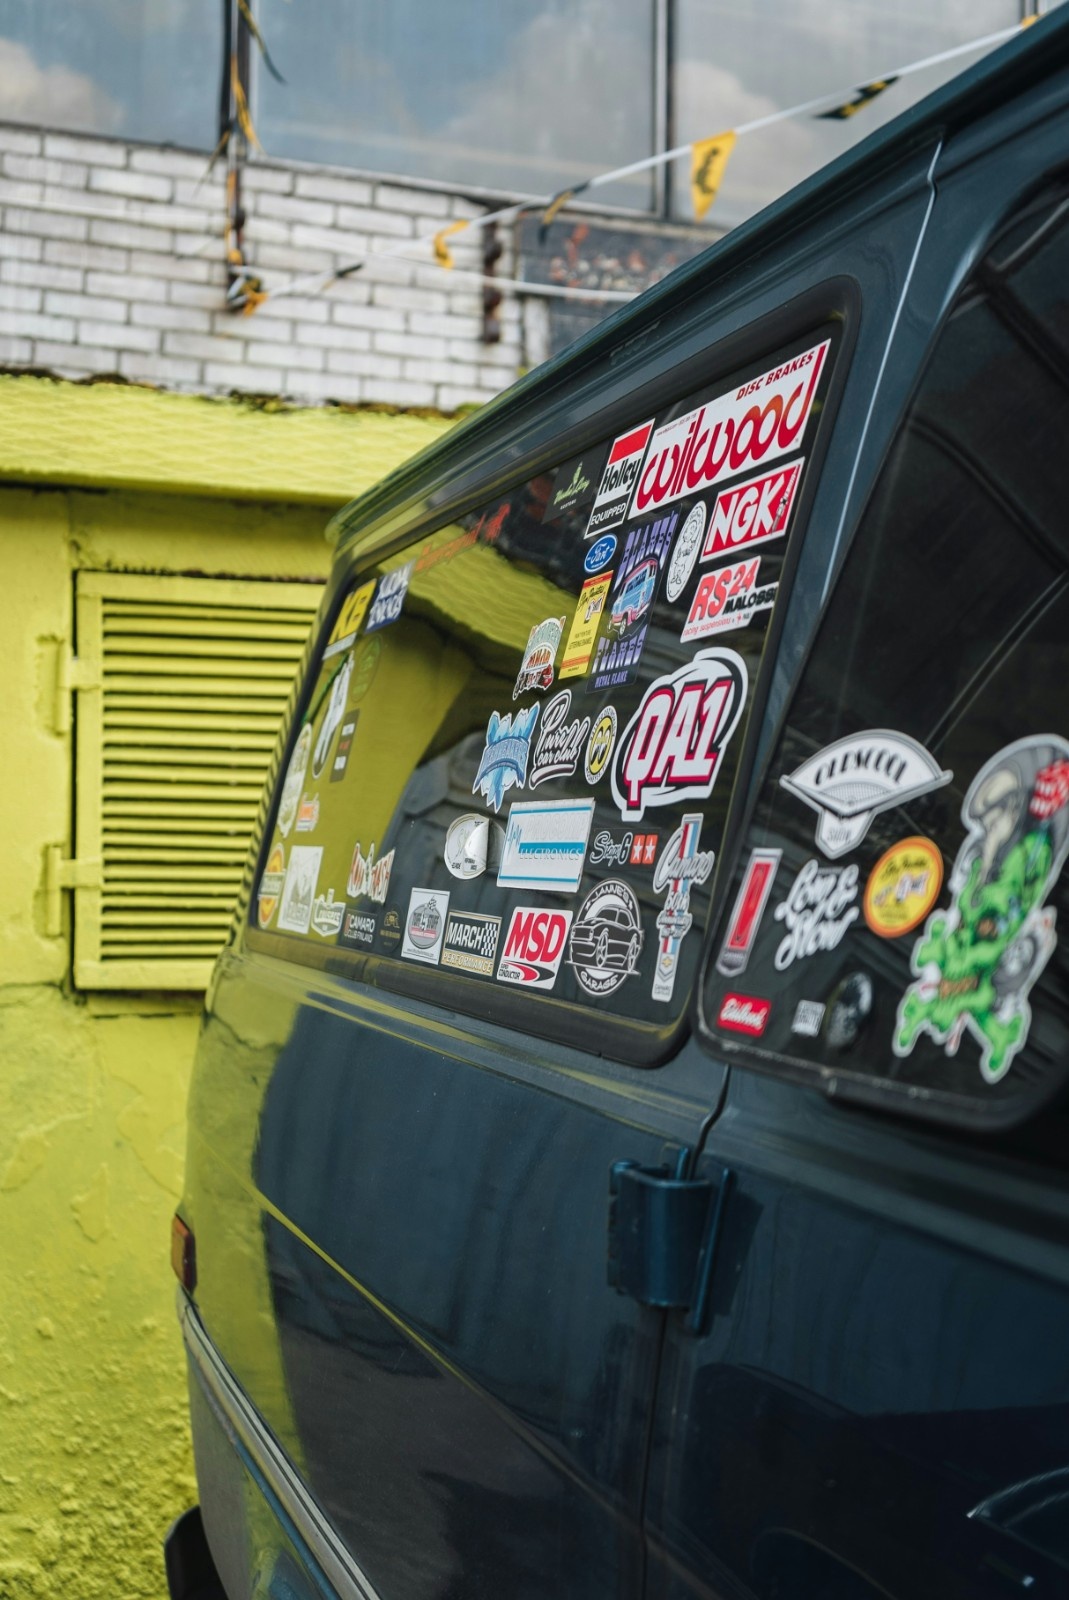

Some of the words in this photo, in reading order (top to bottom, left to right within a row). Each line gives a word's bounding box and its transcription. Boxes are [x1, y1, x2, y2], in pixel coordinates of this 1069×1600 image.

[736, 378, 764, 401] DISC
[765, 350, 815, 387] BRAKES
[636, 343, 827, 511] wilwood
[599, 457, 641, 496] Holley
[590, 502, 627, 526] EQUIPPED
[705, 472, 785, 553] NGK
[590, 542, 611, 565] Ford
[683, 626, 699, 637] racing
[700, 617, 732, 632] suspensions
[624, 678, 736, 811] QA1
[520, 847, 582, 861] ELECTRONICS
[594, 884, 630, 901] JANNE'S
[349, 914, 375, 933] CAMARO
[445, 921, 485, 951] MARCH
[504, 912, 567, 963] MSD
[443, 952, 494, 973] PERFORMANCE
[498, 967, 521, 981] CONDUCTOR
[580, 971, 619, 991] GARAGE
